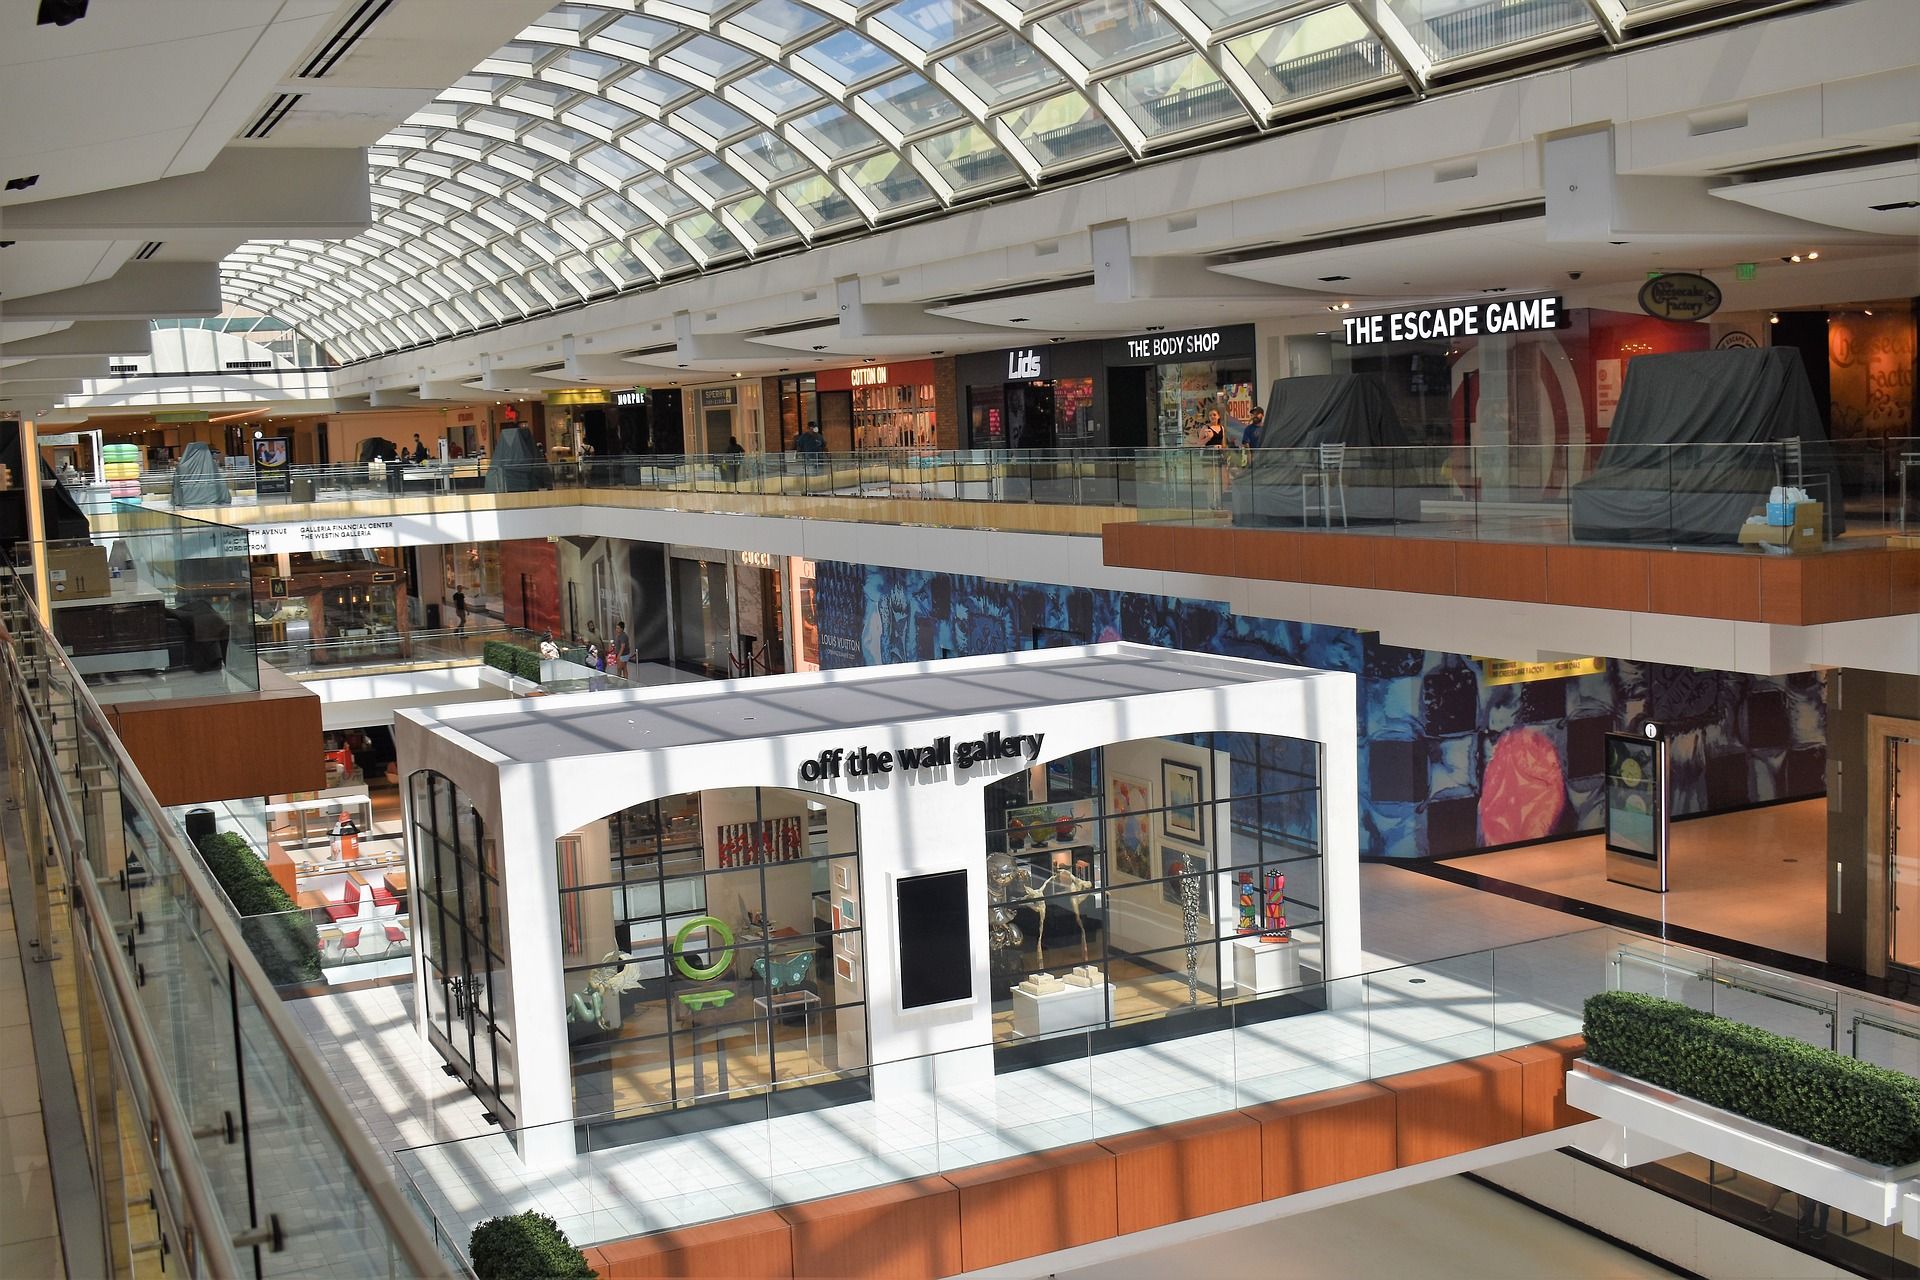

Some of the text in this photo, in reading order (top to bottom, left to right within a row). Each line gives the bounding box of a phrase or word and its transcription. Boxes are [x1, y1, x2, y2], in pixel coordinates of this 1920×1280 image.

[1662, 296, 1703, 316] Factory
[1343, 298, 1555, 345] THE ESCAPE GAME
[1128, 332, 1220, 358] THE BODY SHOP
[1008, 350, 1040, 379] Lids
[851, 366, 887, 386] COTTON ON
[617, 392, 645, 406] MORPHE
[1229, 400, 1250, 419] PRIDE
[262, 528, 287, 536] AVENUE
[300, 521, 393, 534] GALLERIA FINANCIAL CENTER
[301, 530, 371, 541] THE WESTIN GALLERIA
[741, 550, 771, 566] GUCCI
[821, 634, 860, 652] LOUIS VUITTON
[801, 731, 1045, 782] off the wall gallery
